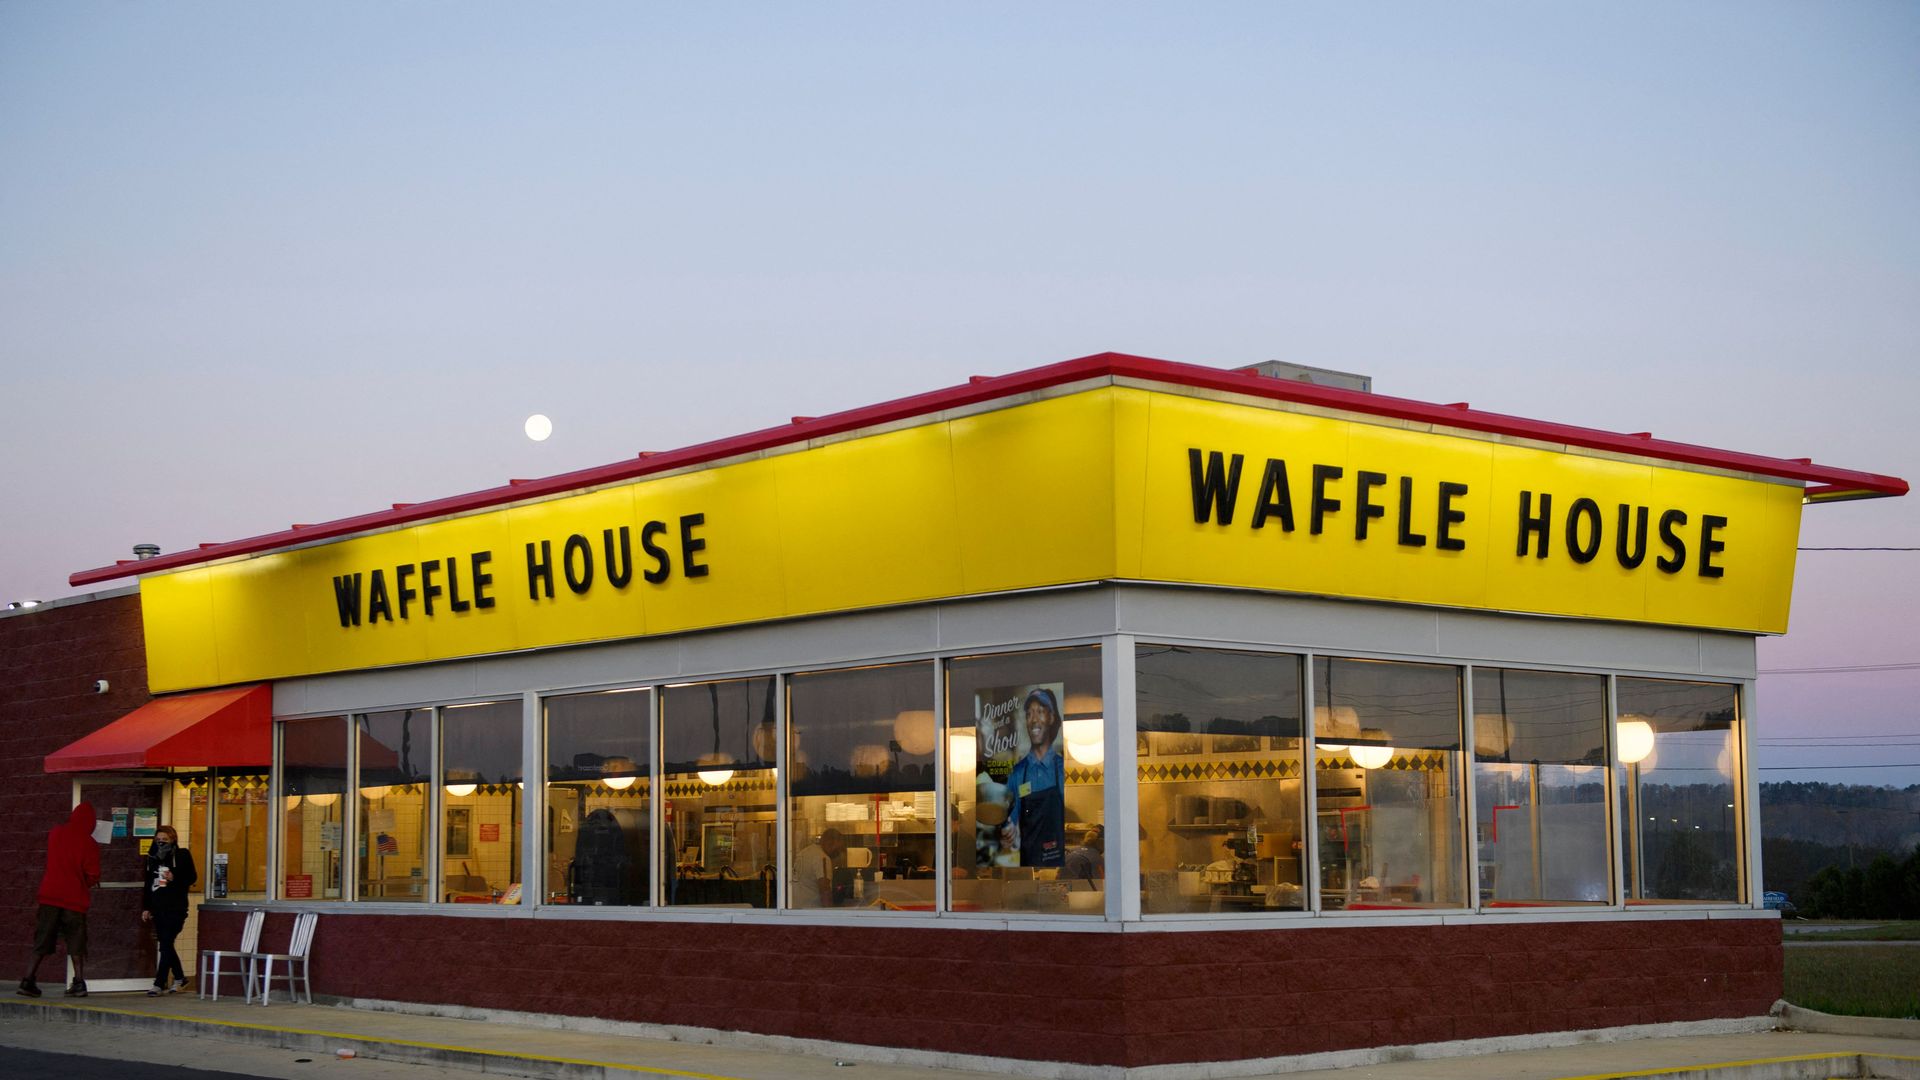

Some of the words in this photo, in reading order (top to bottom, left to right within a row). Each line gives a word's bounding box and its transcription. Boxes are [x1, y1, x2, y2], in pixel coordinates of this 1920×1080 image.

[332, 551, 496, 628] WAFFLE
[526, 513, 710, 600] HOUSE
[1188, 448, 1469, 552] WAFFLE
[1516, 491, 1728, 580] HOUSE
[983, 696, 1020, 722] Dinner
